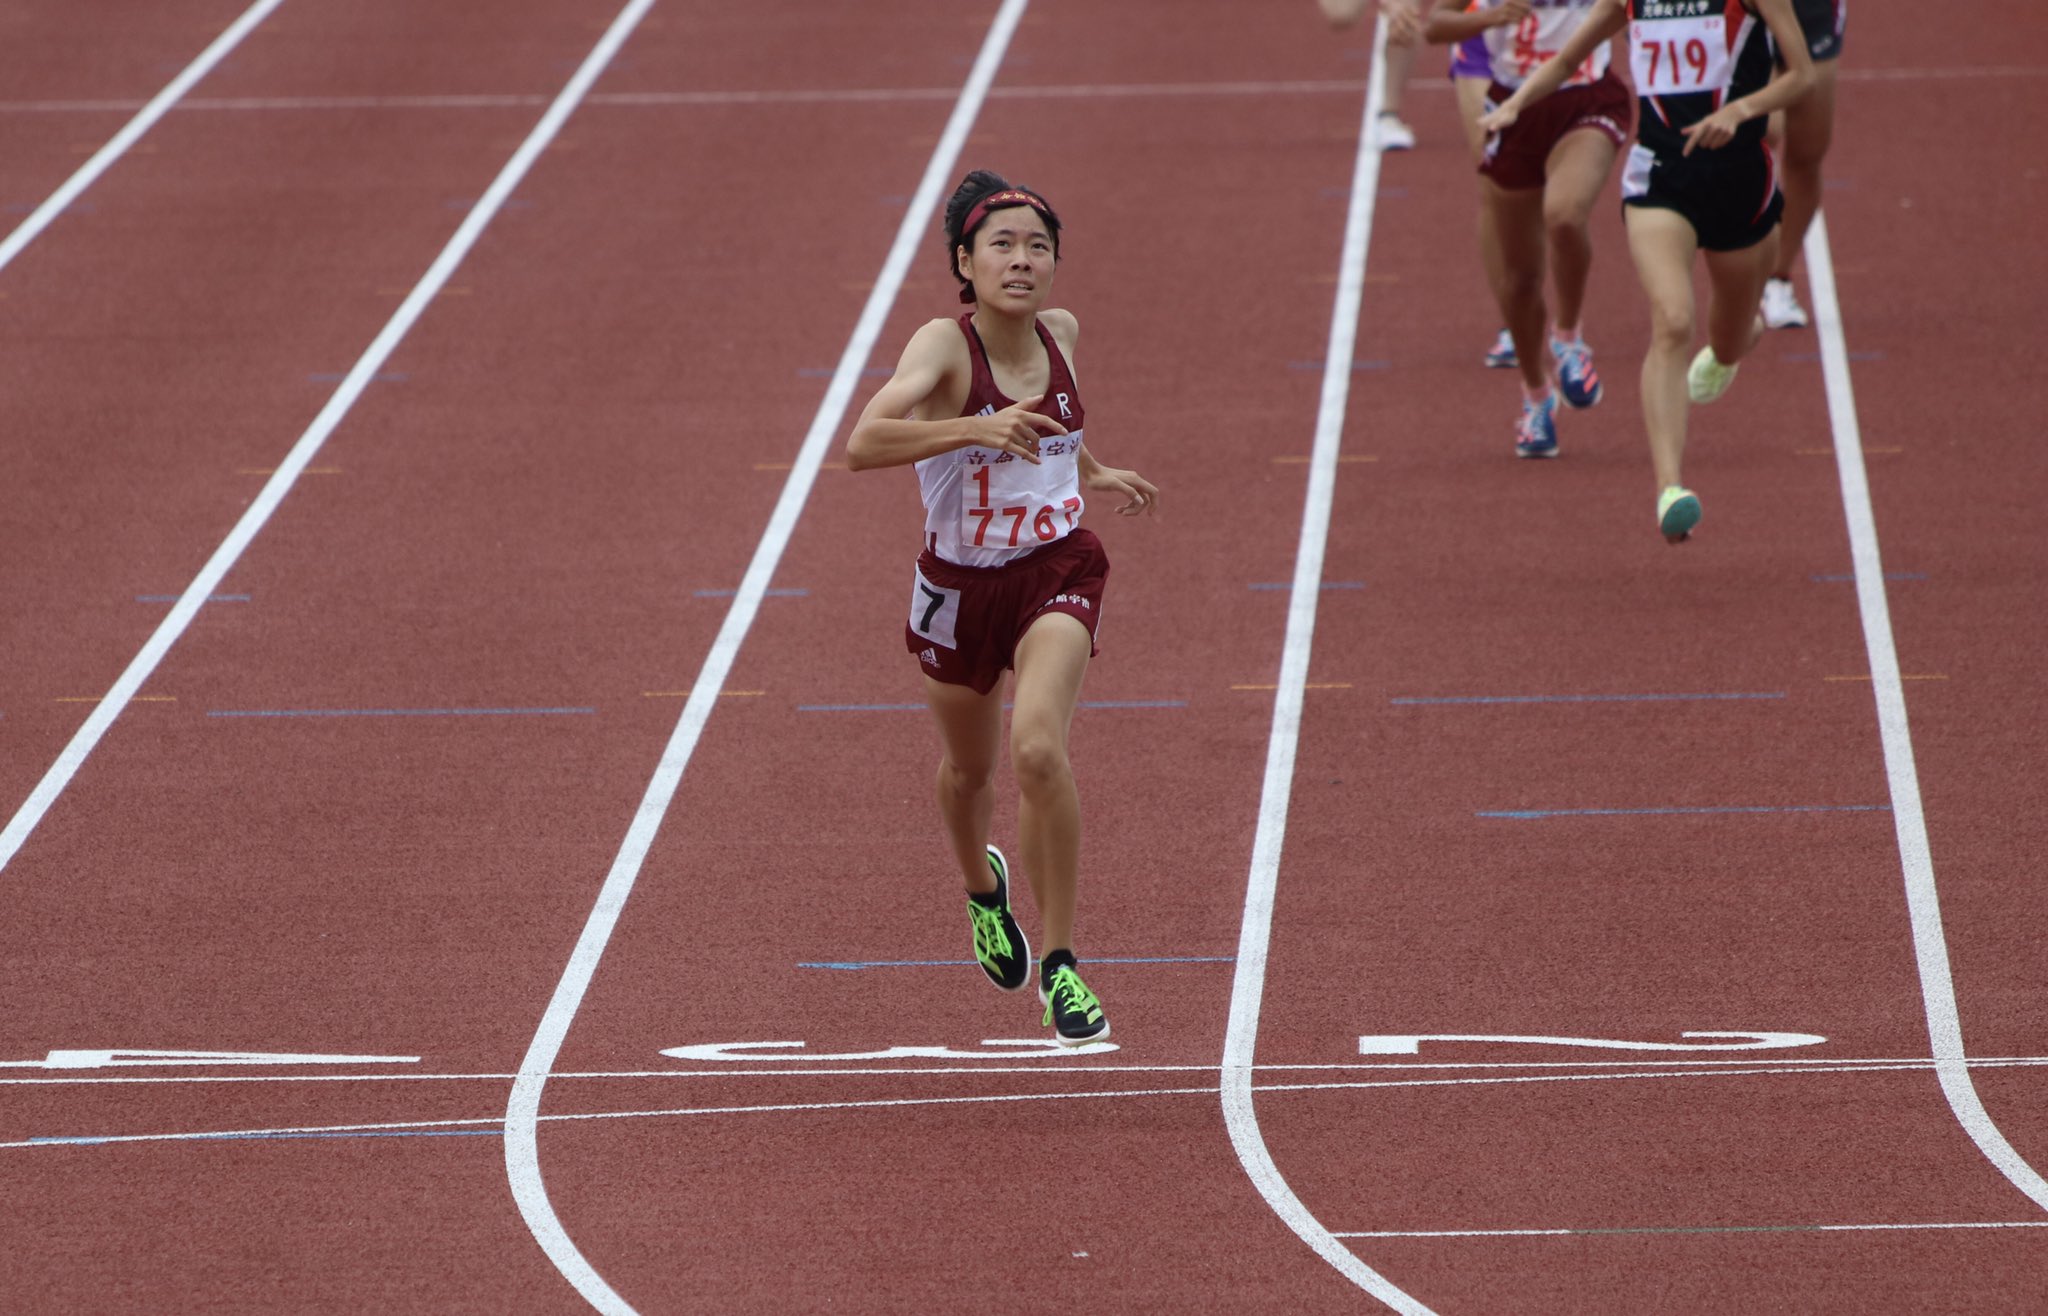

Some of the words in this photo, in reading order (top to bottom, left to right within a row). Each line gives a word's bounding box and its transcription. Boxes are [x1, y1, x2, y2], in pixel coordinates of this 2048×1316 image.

[1642, 38, 1708, 87] 719
[1056, 392, 1072, 416] R
[972, 465, 990, 508] 1
[968, 496, 1081, 547] 7767
[920, 582, 945, 633] 7
